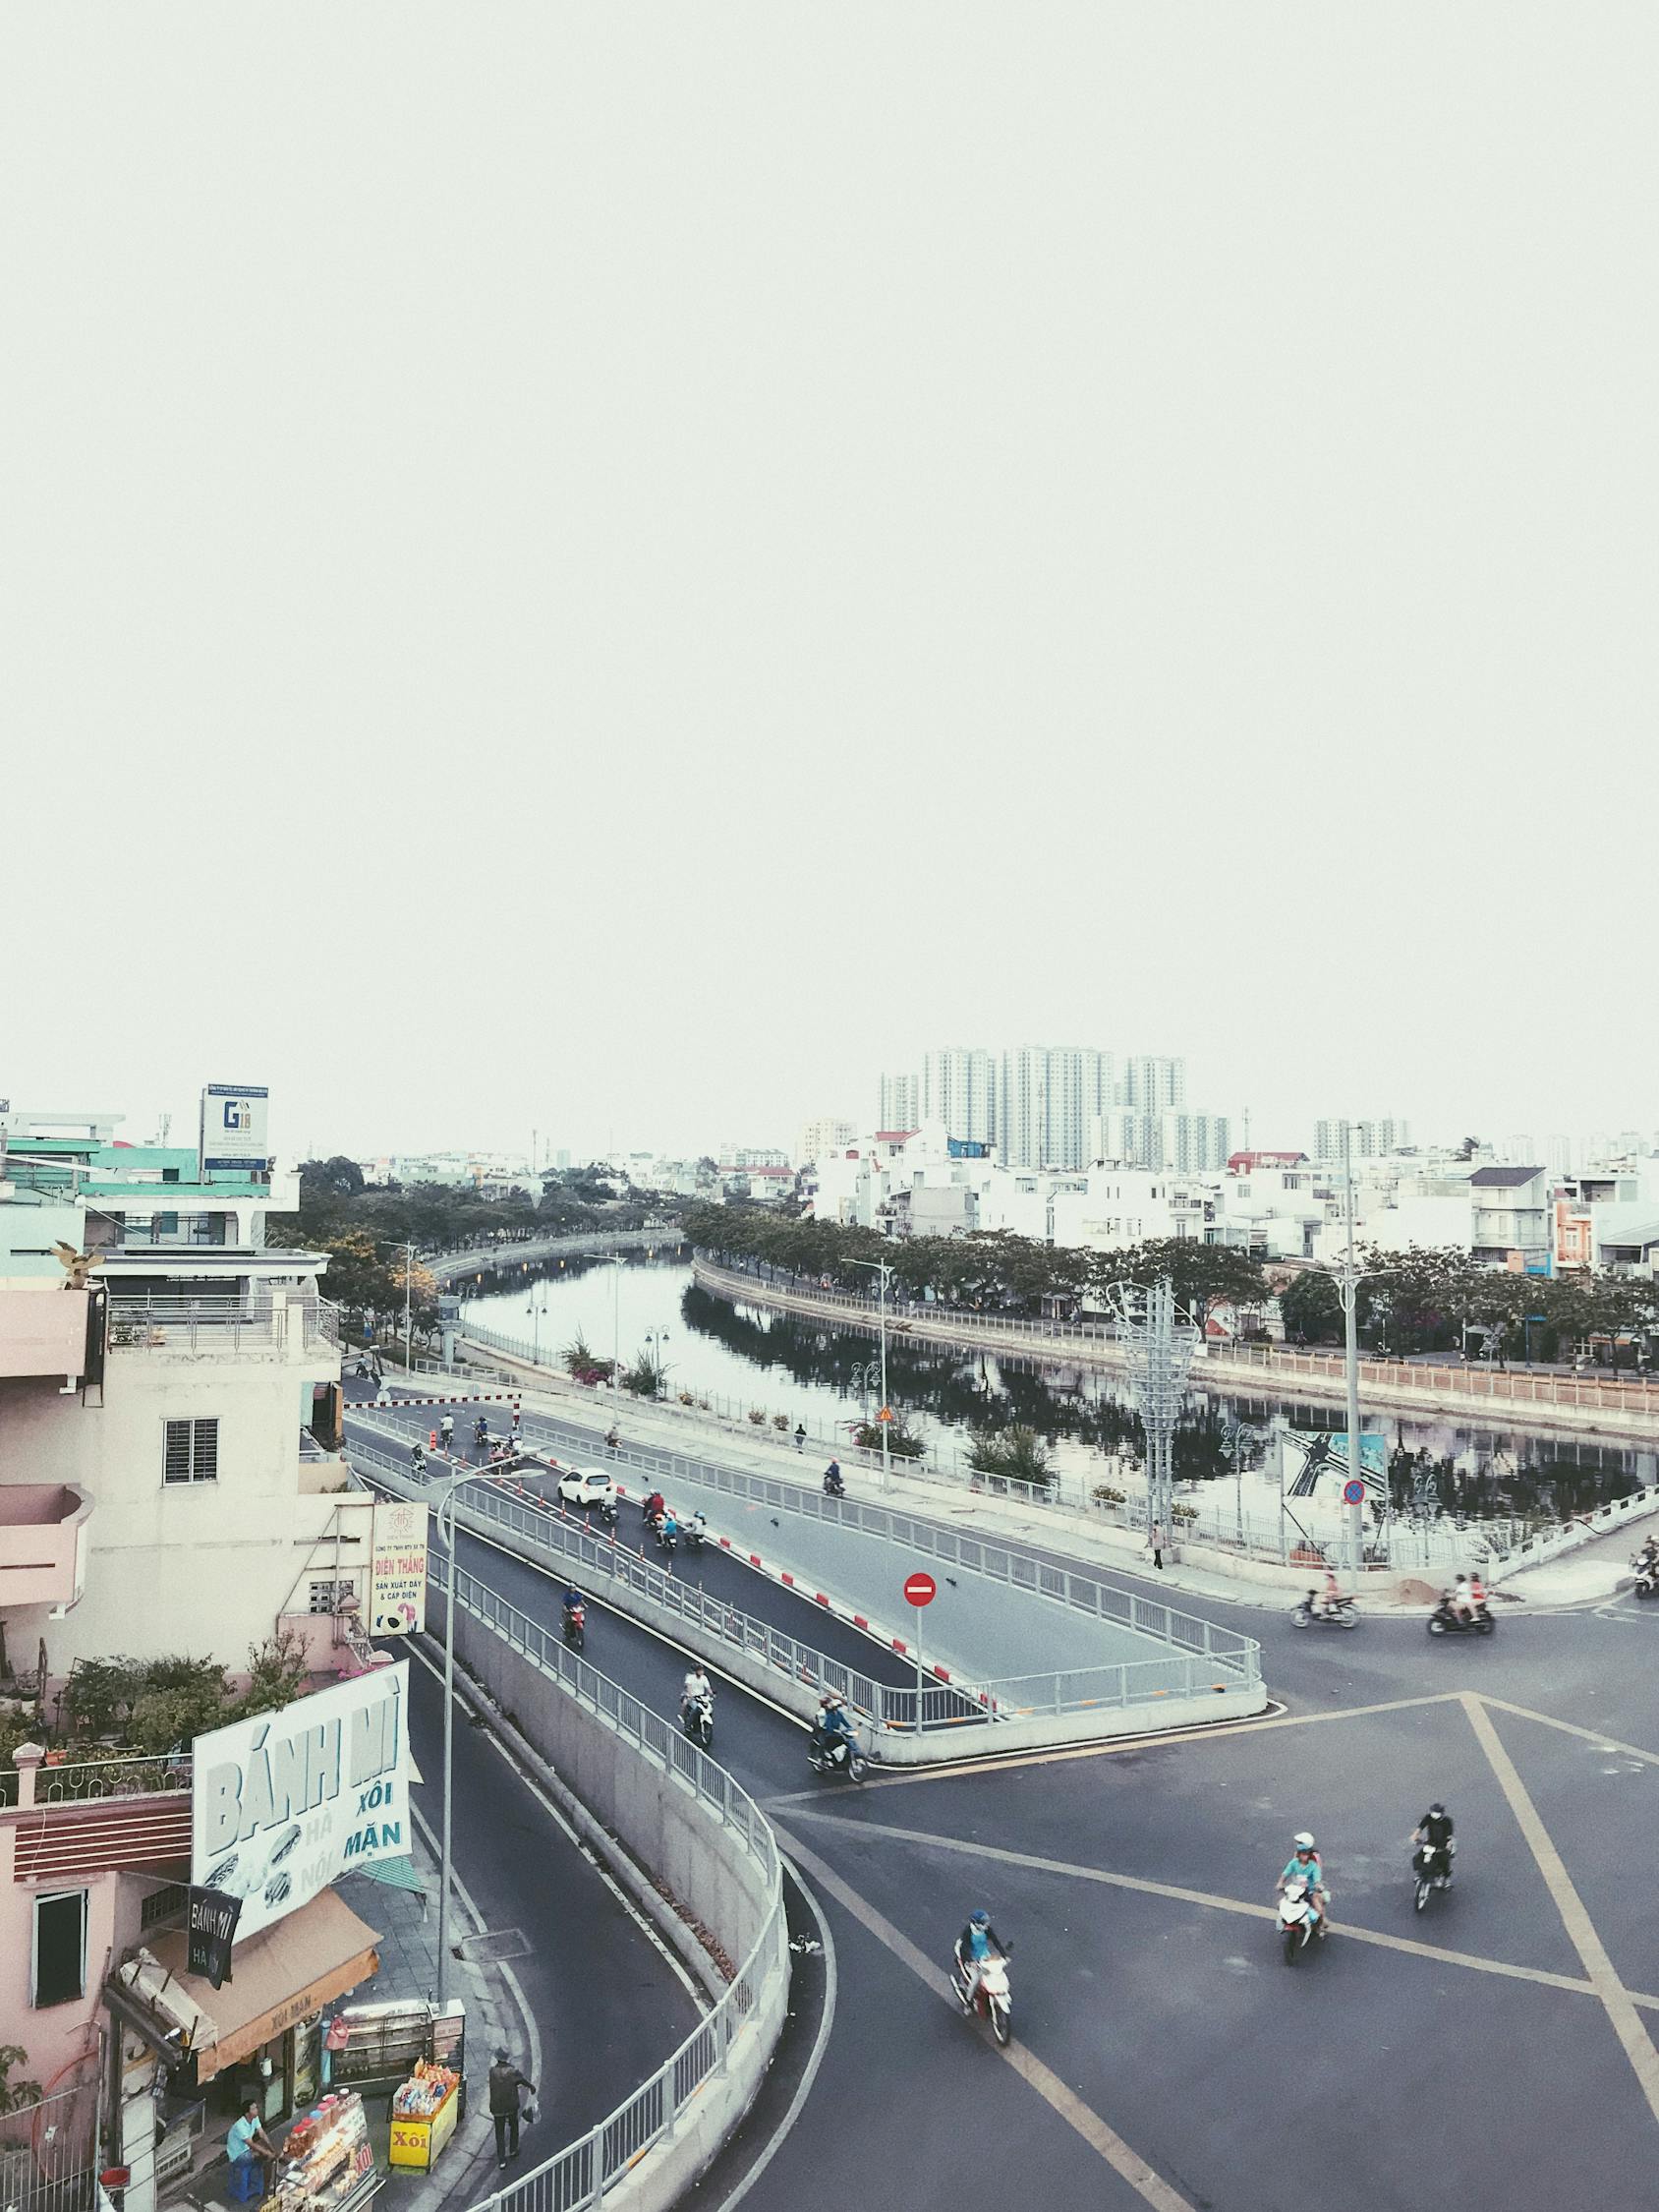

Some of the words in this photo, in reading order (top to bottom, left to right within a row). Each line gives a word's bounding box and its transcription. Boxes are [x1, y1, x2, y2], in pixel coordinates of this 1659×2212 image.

[206, 1717, 341, 1856] BÁNH
[350, 1674, 401, 1788] MÌ
[357, 1779, 392, 1817] XÔI
[306, 1808, 332, 1845] HÀ
[344, 1821, 401, 1859] MẶN
[192, 1898, 216, 1935] BÁNH
[216, 1905, 234, 1940] MÌ
[193, 1946, 207, 1966] HÀ
[393, 2130, 427, 2148] Xôi
